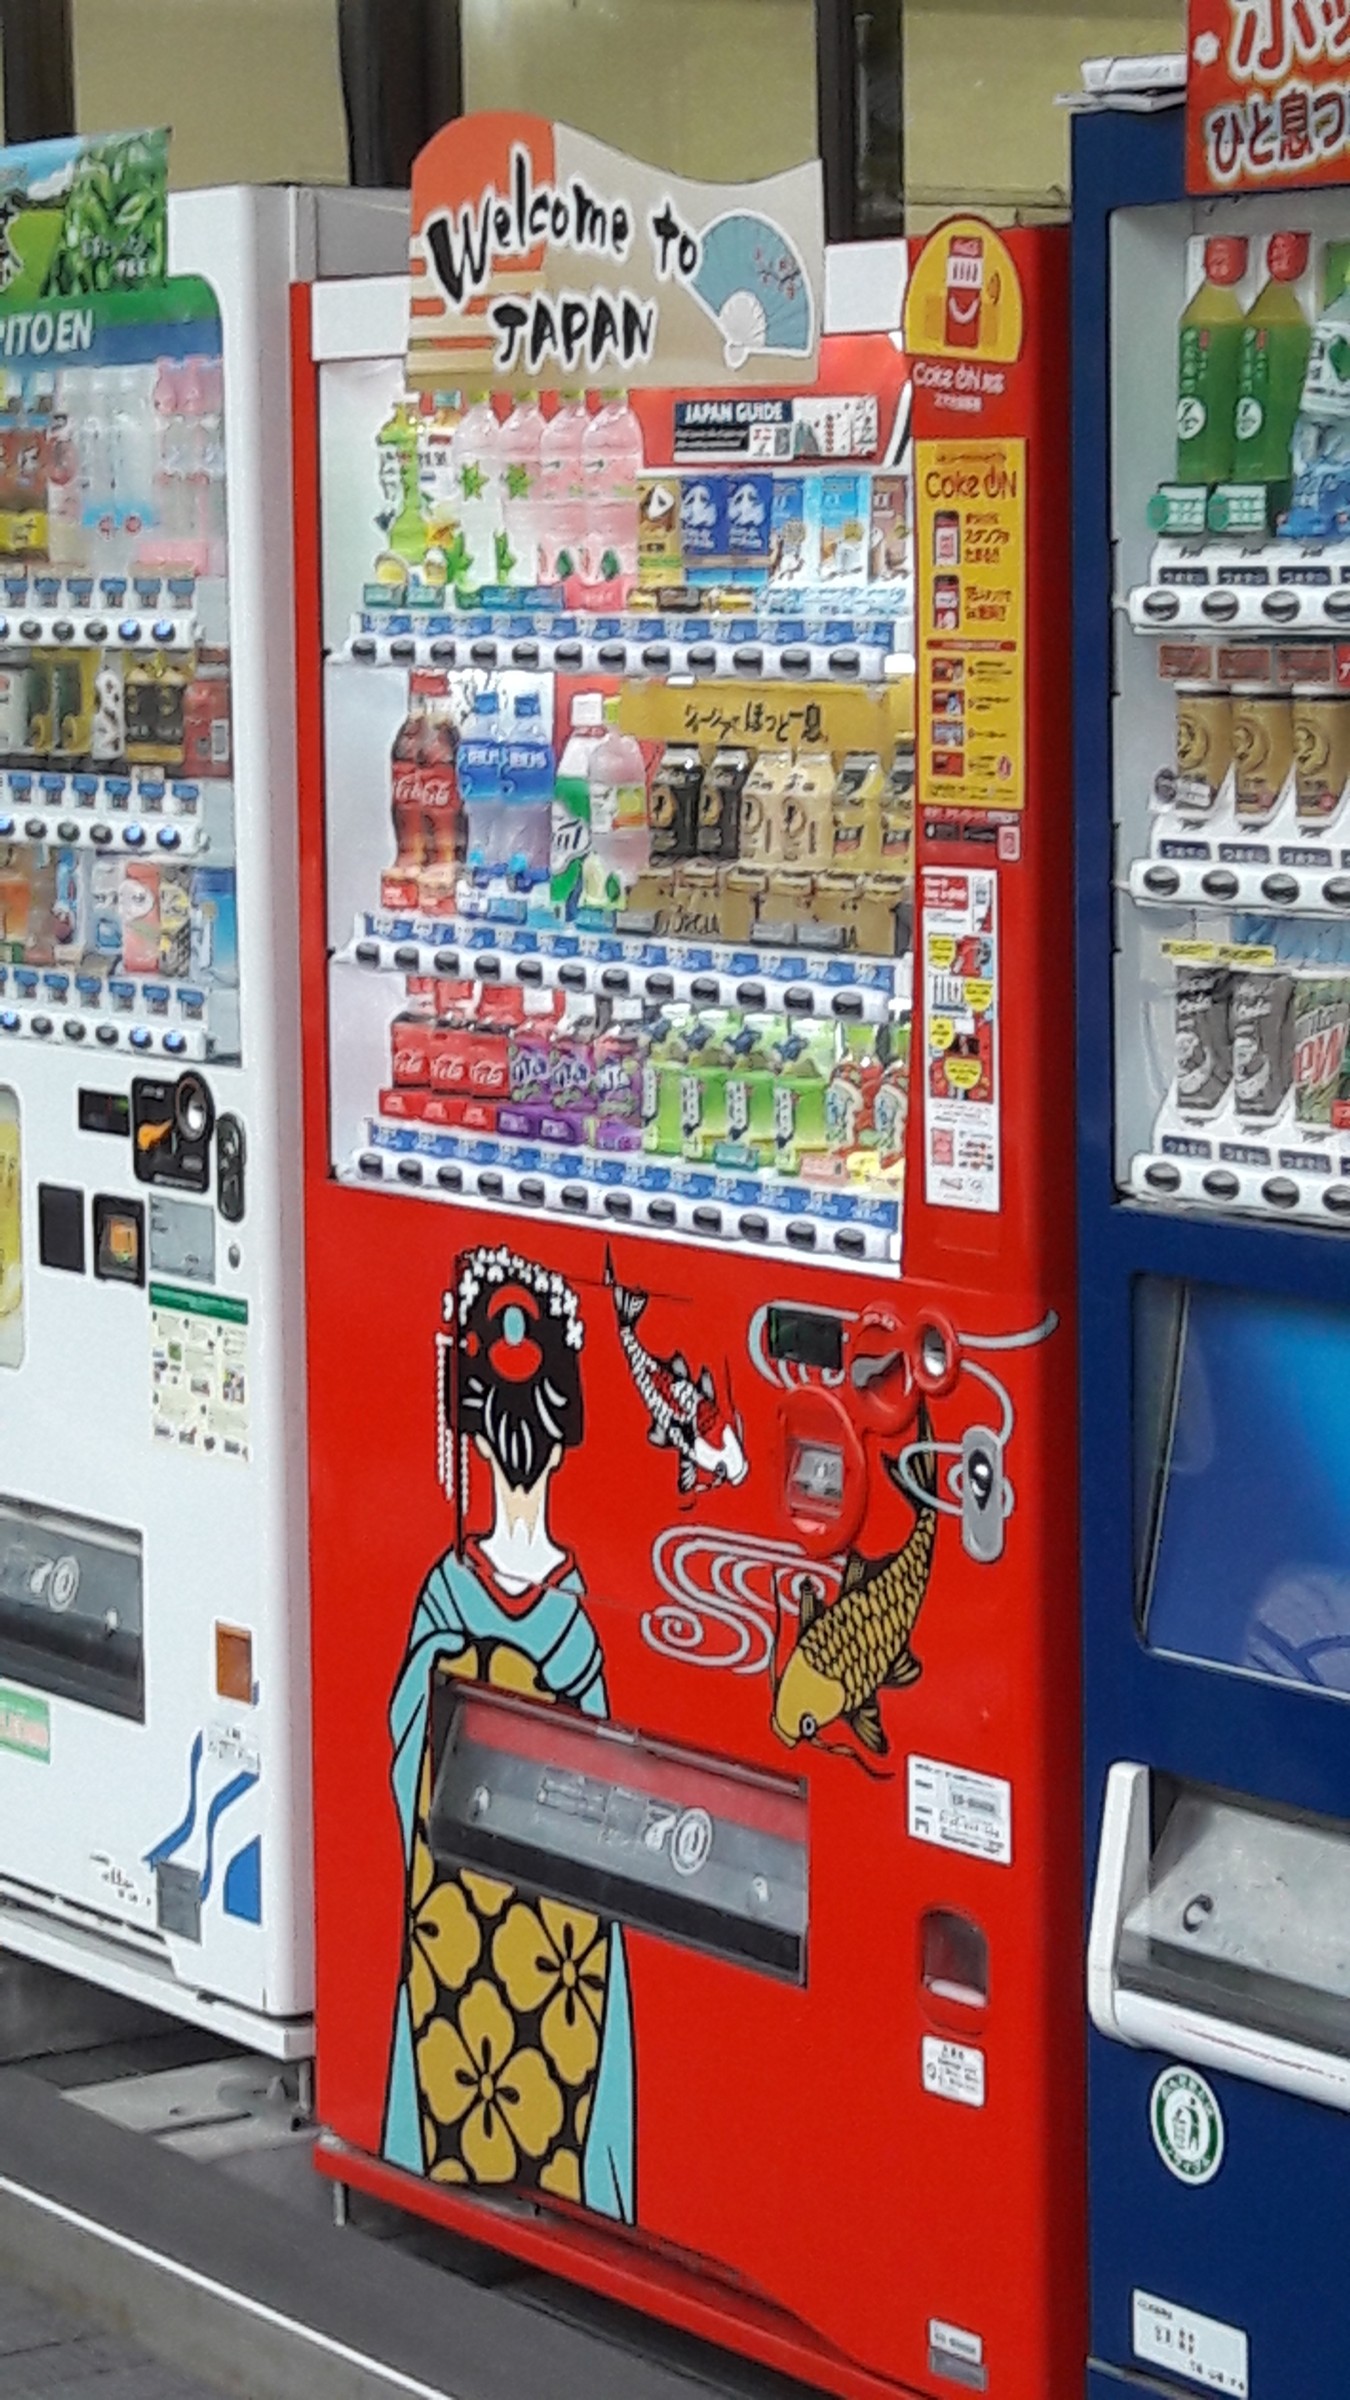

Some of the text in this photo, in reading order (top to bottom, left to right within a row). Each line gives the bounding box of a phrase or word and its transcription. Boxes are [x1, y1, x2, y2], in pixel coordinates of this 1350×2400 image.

[426, 151, 698, 304] Welcome to
[492, 296, 654, 364] JAPAN
[684, 401, 783, 424] JAPAN GUIDE
[925, 465, 1018, 499] Coke ON
